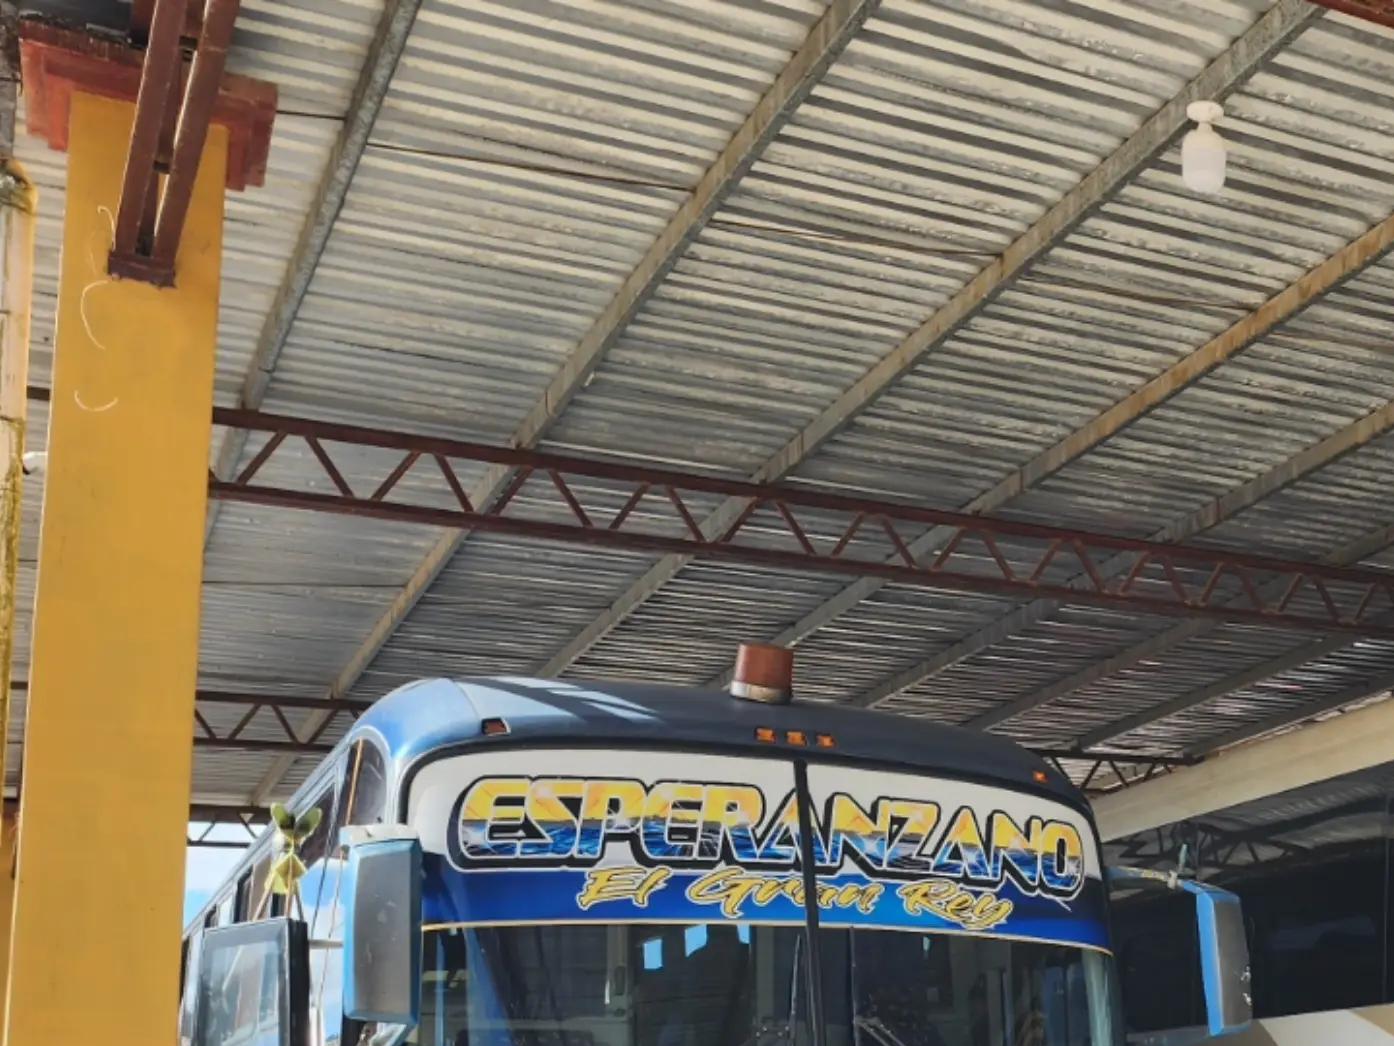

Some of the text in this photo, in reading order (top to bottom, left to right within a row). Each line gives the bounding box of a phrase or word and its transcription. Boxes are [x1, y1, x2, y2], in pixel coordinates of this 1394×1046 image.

[454, 775, 1085, 897] ESPERANZANO
[578, 866, 1013, 930] El Gran Rey
